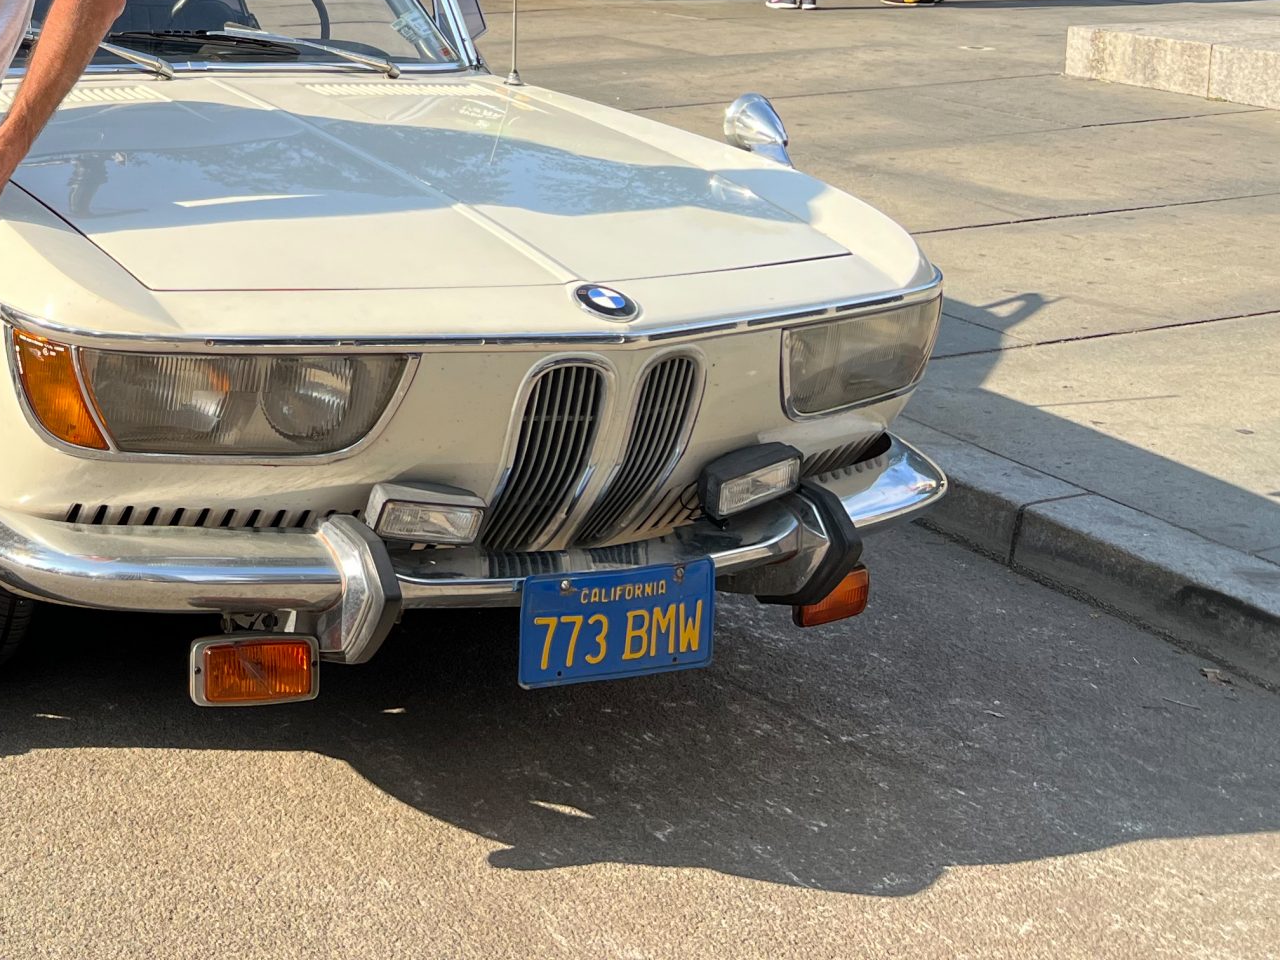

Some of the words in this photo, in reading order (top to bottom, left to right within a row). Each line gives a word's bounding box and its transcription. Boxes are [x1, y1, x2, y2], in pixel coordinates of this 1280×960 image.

[580, 579, 666, 604] CALIFORNIA
[534, 613, 609, 670] 773
[622, 599, 703, 660] BMW
